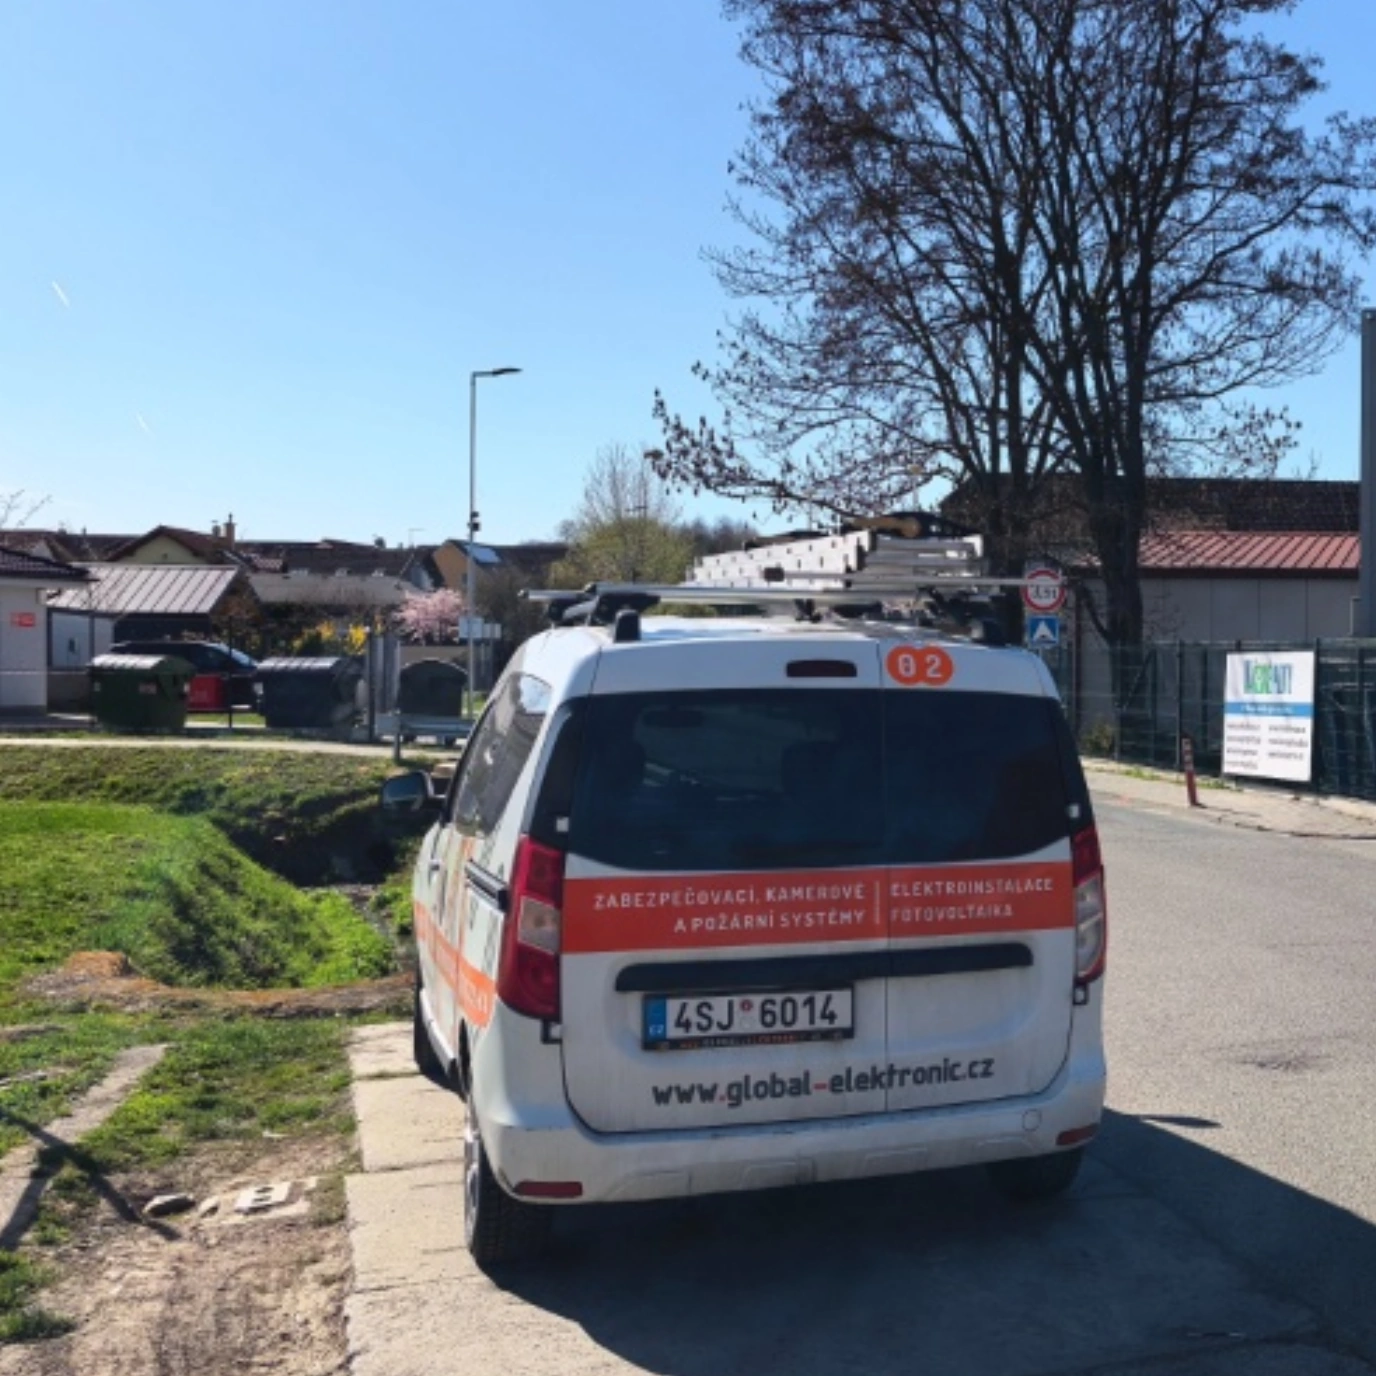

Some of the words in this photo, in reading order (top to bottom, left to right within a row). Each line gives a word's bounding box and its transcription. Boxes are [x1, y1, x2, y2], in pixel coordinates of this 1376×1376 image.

[766, 881, 865, 904] KAMEROVÉ
[890, 877, 1054, 898] ELEKTROINSTALACE
[673, 917, 687, 933] A
[691, 909, 774, 932] POŽÁRNÍ
[780, 907, 865, 929] SYSTÉMY
[890, 903, 1014, 923] FOTOVOLTAIKA
[674, 999, 735, 1033] 4SJ
[759, 994, 838, 1029] 6014
[652, 1057, 995, 1109] www.global-elektronic.cz
